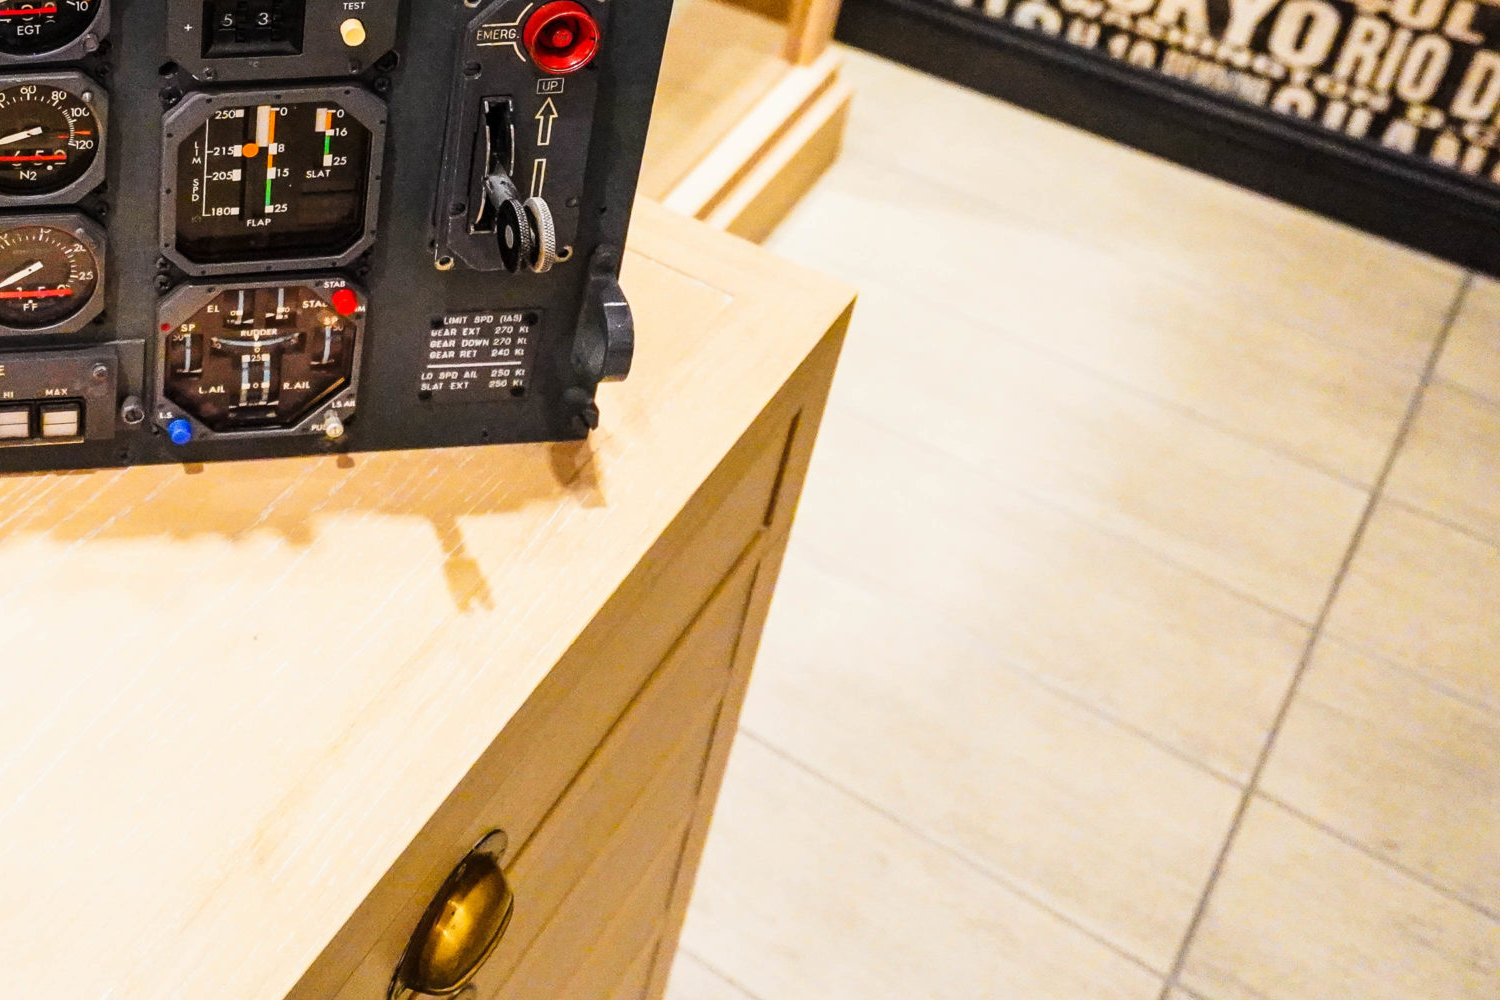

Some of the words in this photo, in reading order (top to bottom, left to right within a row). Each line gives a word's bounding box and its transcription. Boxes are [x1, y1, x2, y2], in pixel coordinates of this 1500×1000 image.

[343, 1, 366, 10] TEST
[16, 25, 41, 36] EGT
[476, 28, 520, 42] EMERG.
[1333, 13, 1453, 102] RIO
[542, 80, 559, 92] UP
[215, 110, 236, 120] 250
[334, 128, 348, 137] 16
[213, 146, 234, 156] 215
[333, 156, 347, 166] 25
[20, 170, 38, 182] N2
[212, 171, 233, 181] 205
[276, 168, 290, 177] 15
[305, 169, 331, 179] SLAT
[211, 207, 231, 216] 180
[274, 204, 288, 213] 25
[246, 218, 272, 227] FLAP
[323, 280, 346, 289] STAB
[443, 315, 468, 325] LIMIT
[474, 315, 494, 324] SPD
[181, 323, 195, 333] SP
[462, 327, 481, 336] EXT
[494, 326, 513, 335] 270
[429, 339, 456, 348] GEAR
[461, 338, 489, 347] DOWN
[493, 337, 511, 346] 270
[429, 350, 455, 359] GEAR
[460, 350, 477, 358] RET
[421, 382, 444, 391] SLAT
[450, 382, 469, 390] EXT
[45, 387, 68, 397] MAX
